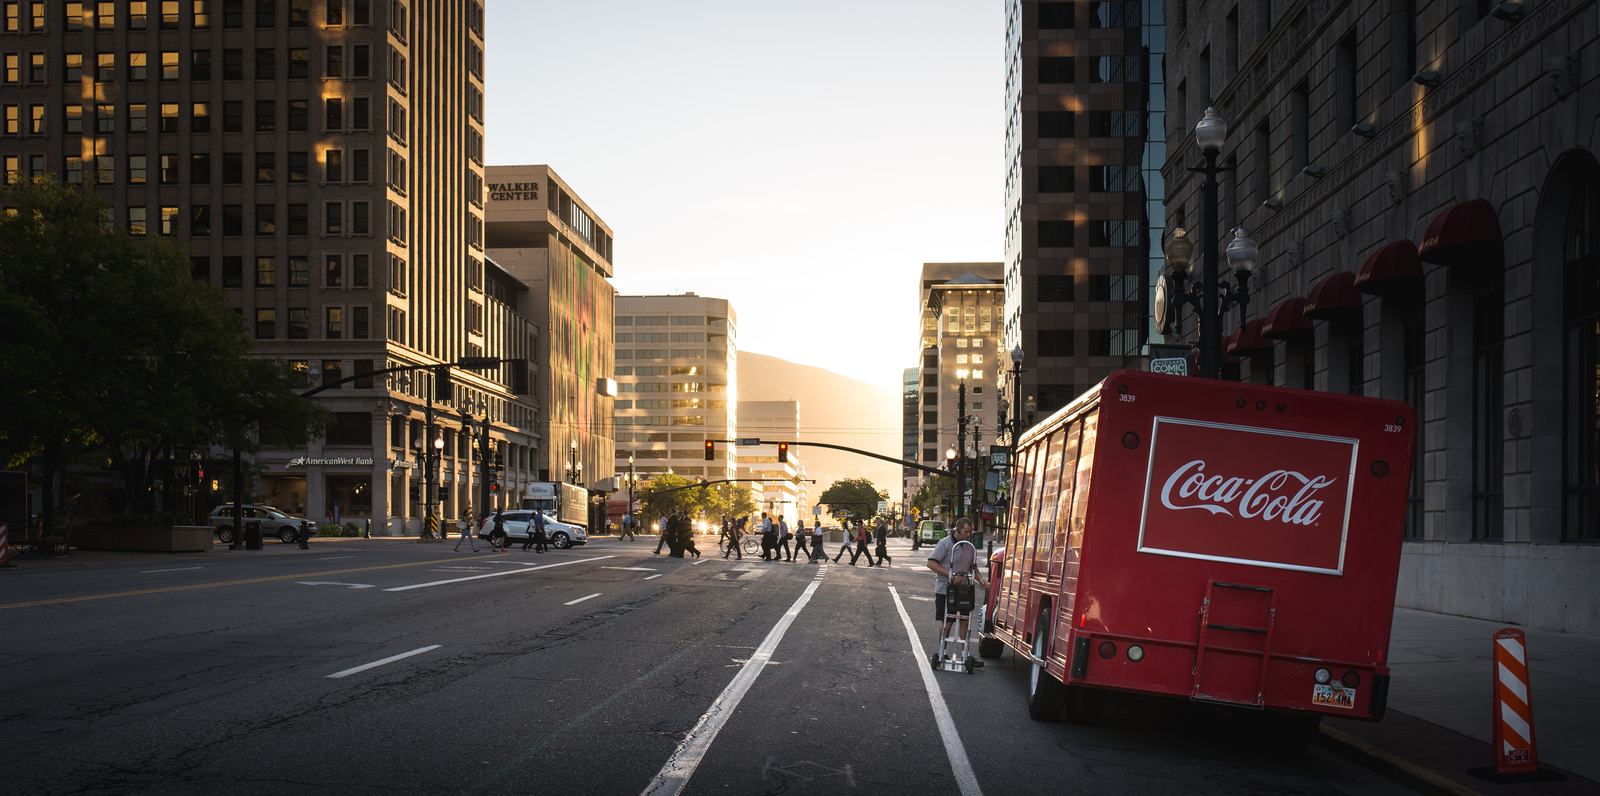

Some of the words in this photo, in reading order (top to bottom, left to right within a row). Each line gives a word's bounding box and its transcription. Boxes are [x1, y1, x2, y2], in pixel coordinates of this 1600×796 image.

[488, 182, 539, 192] WALKER
[491, 191, 538, 201] CENTER
[1153, 363, 1185, 373] COMIC
[1119, 393, 1136, 403] 3839
[1384, 423, 1402, 433] 3839
[305, 456, 354, 466] AmericanWest
[355, 456, 374, 466] Bank
[1160, 459, 1338, 527] Coca-Cola
